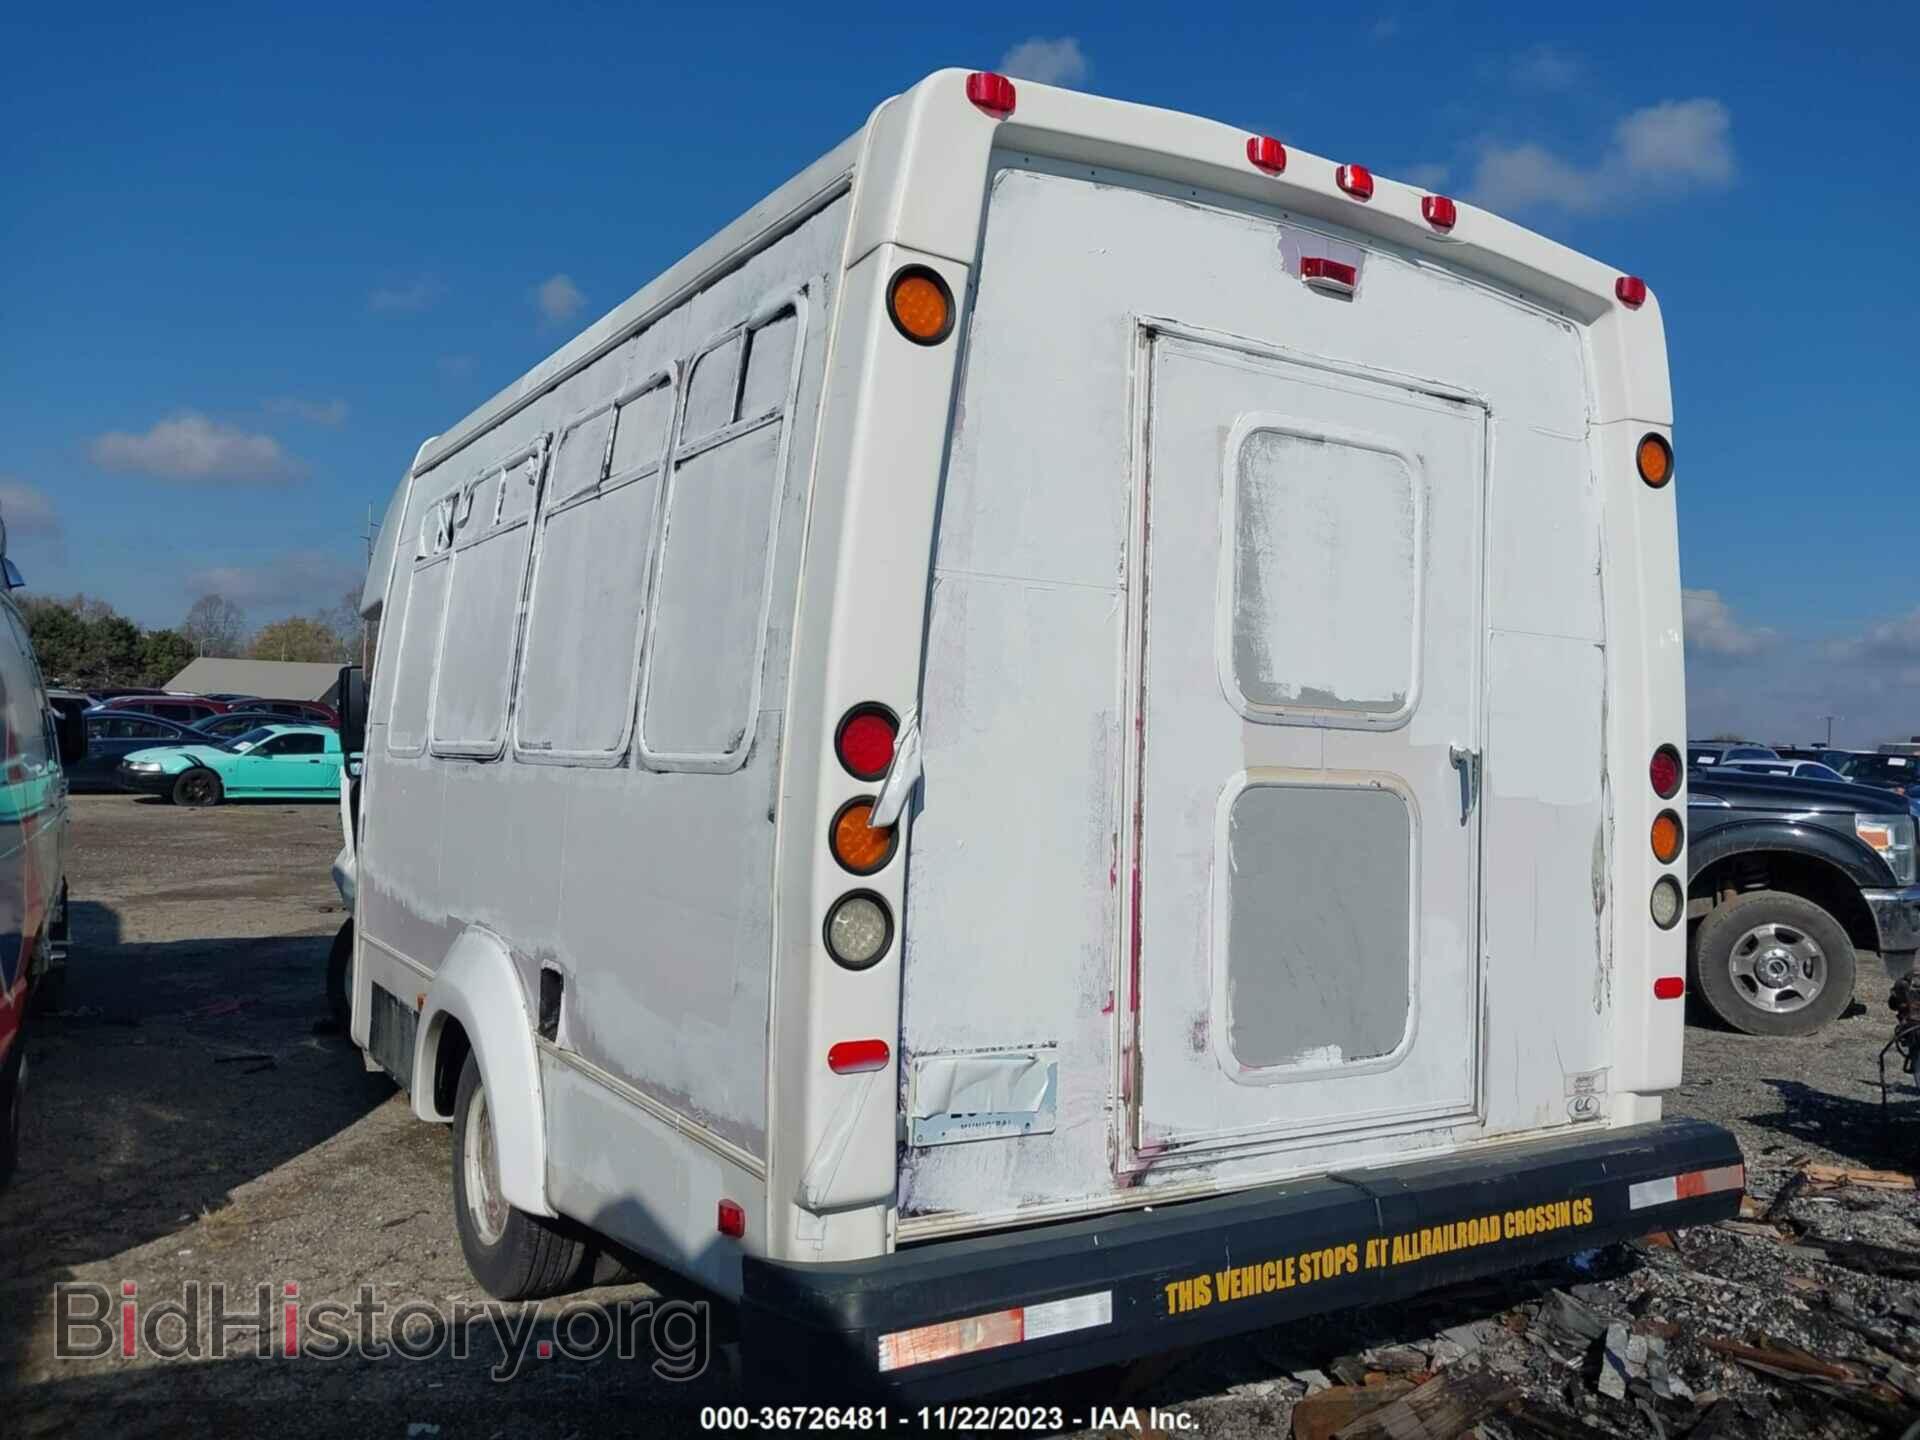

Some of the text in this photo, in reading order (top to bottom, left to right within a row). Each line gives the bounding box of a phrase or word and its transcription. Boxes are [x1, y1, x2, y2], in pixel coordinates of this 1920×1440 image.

[1165, 1274, 1212, 1314] THIS
[1215, 1257, 1296, 1302] VEHICLE
[1299, 1243, 1358, 1284] STOPS
[1365, 1238, 1389, 1268] AT
